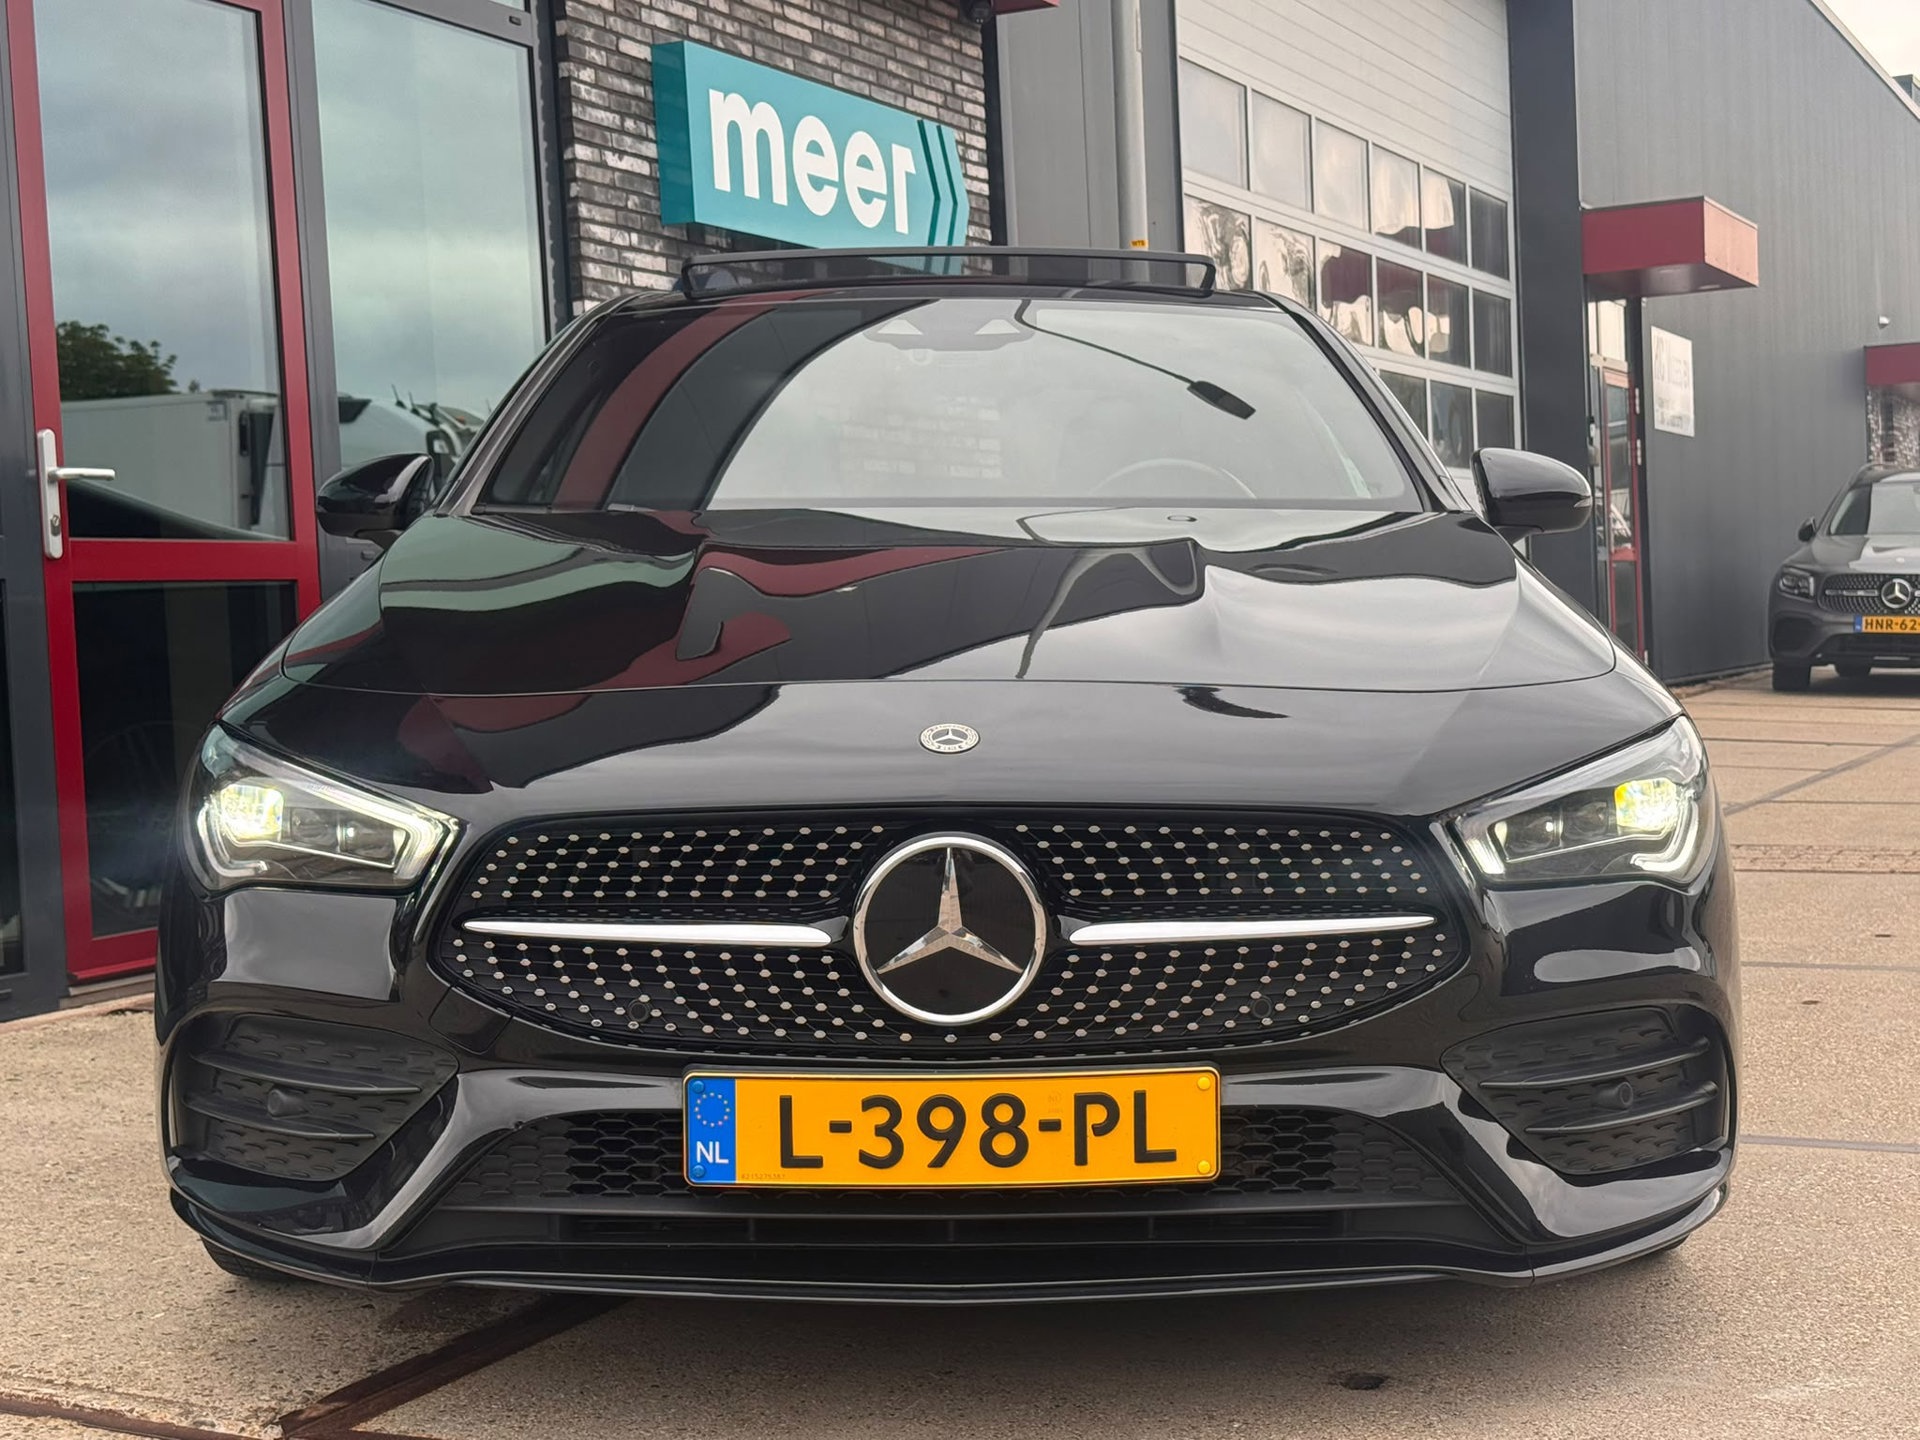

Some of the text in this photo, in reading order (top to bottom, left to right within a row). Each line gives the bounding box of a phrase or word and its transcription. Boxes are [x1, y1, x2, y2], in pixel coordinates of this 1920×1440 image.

[708, 88, 917, 235] meer
[696, 1140, 729, 1164] NL
[778, 1089, 1178, 1170] L-398-PL
